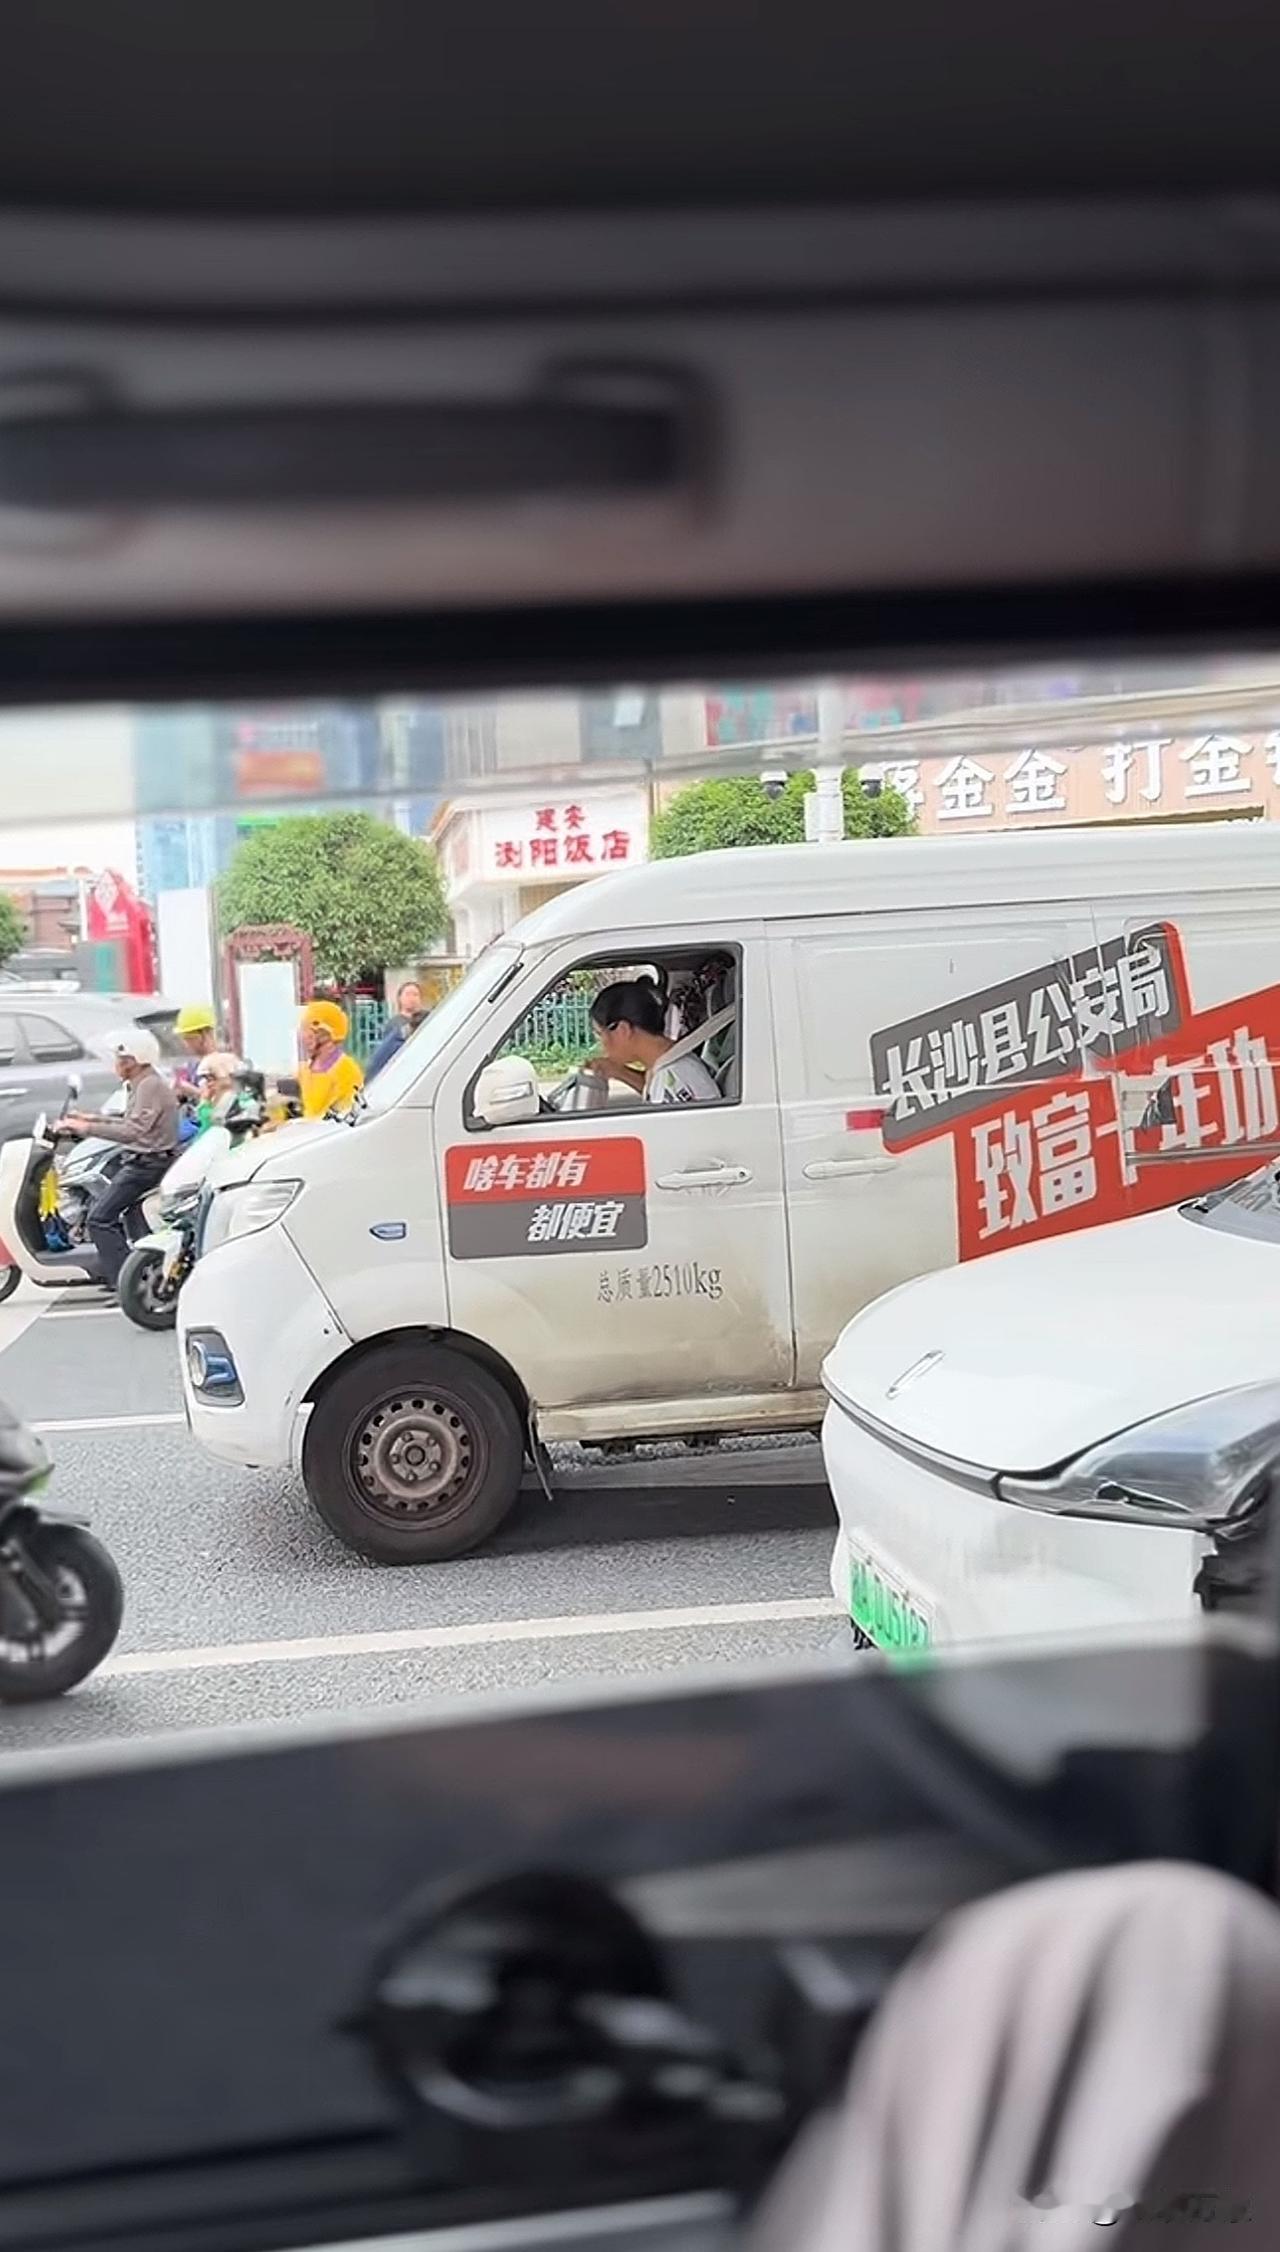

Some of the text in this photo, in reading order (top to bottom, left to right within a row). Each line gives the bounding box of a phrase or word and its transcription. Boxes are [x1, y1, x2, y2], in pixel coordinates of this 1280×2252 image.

[495, 829, 630, 868] 浏阳饭店
[882, 946, 1170, 1121] 长沙县公安局
[463, 1150, 592, 1193] 啥车都有
[527, 1200, 625, 1242] 都便宜
